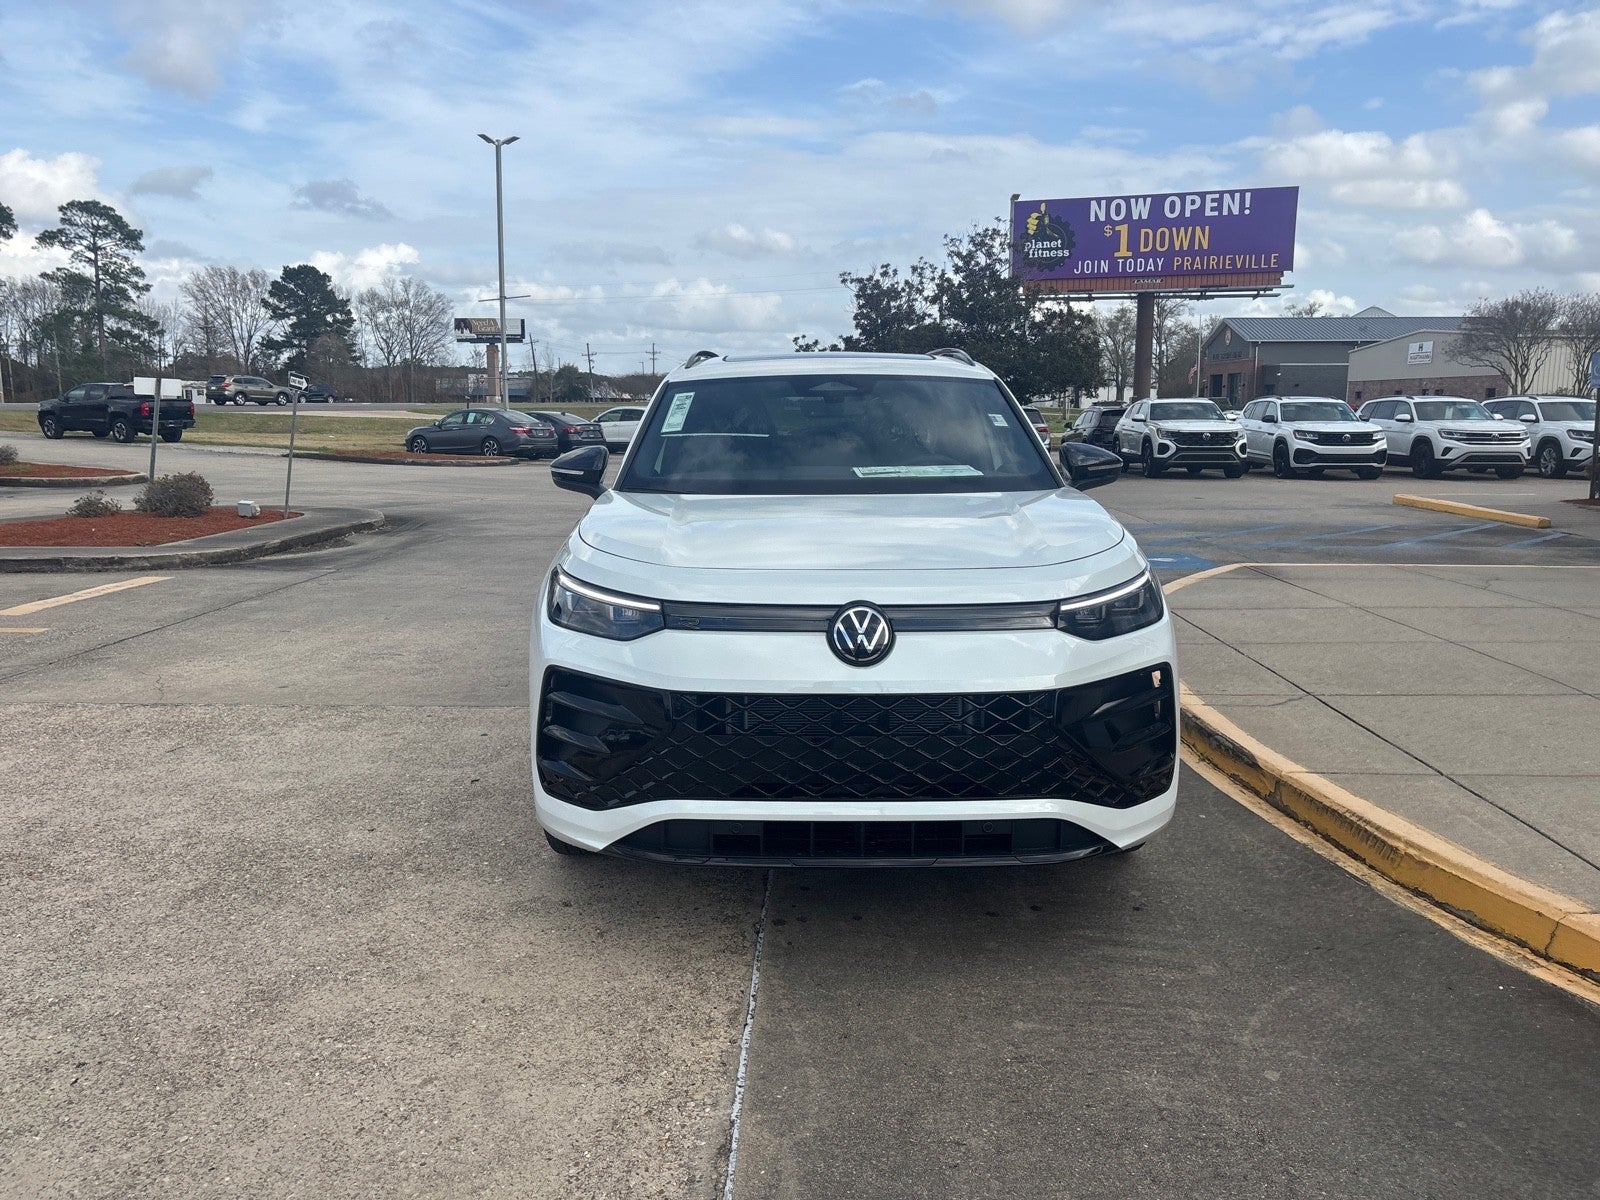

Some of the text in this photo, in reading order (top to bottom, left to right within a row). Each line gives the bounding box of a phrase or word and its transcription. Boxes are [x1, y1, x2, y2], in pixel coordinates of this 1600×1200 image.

[1089, 192, 1252, 222] NOW OPEN!
[1023, 239, 1062, 252] planet
[1139, 225, 1210, 253] DOWN
[1028, 248, 1070, 259] fitness
[1074, 253, 1280, 275] JOIN TODAY PRAIRIEVILLE
